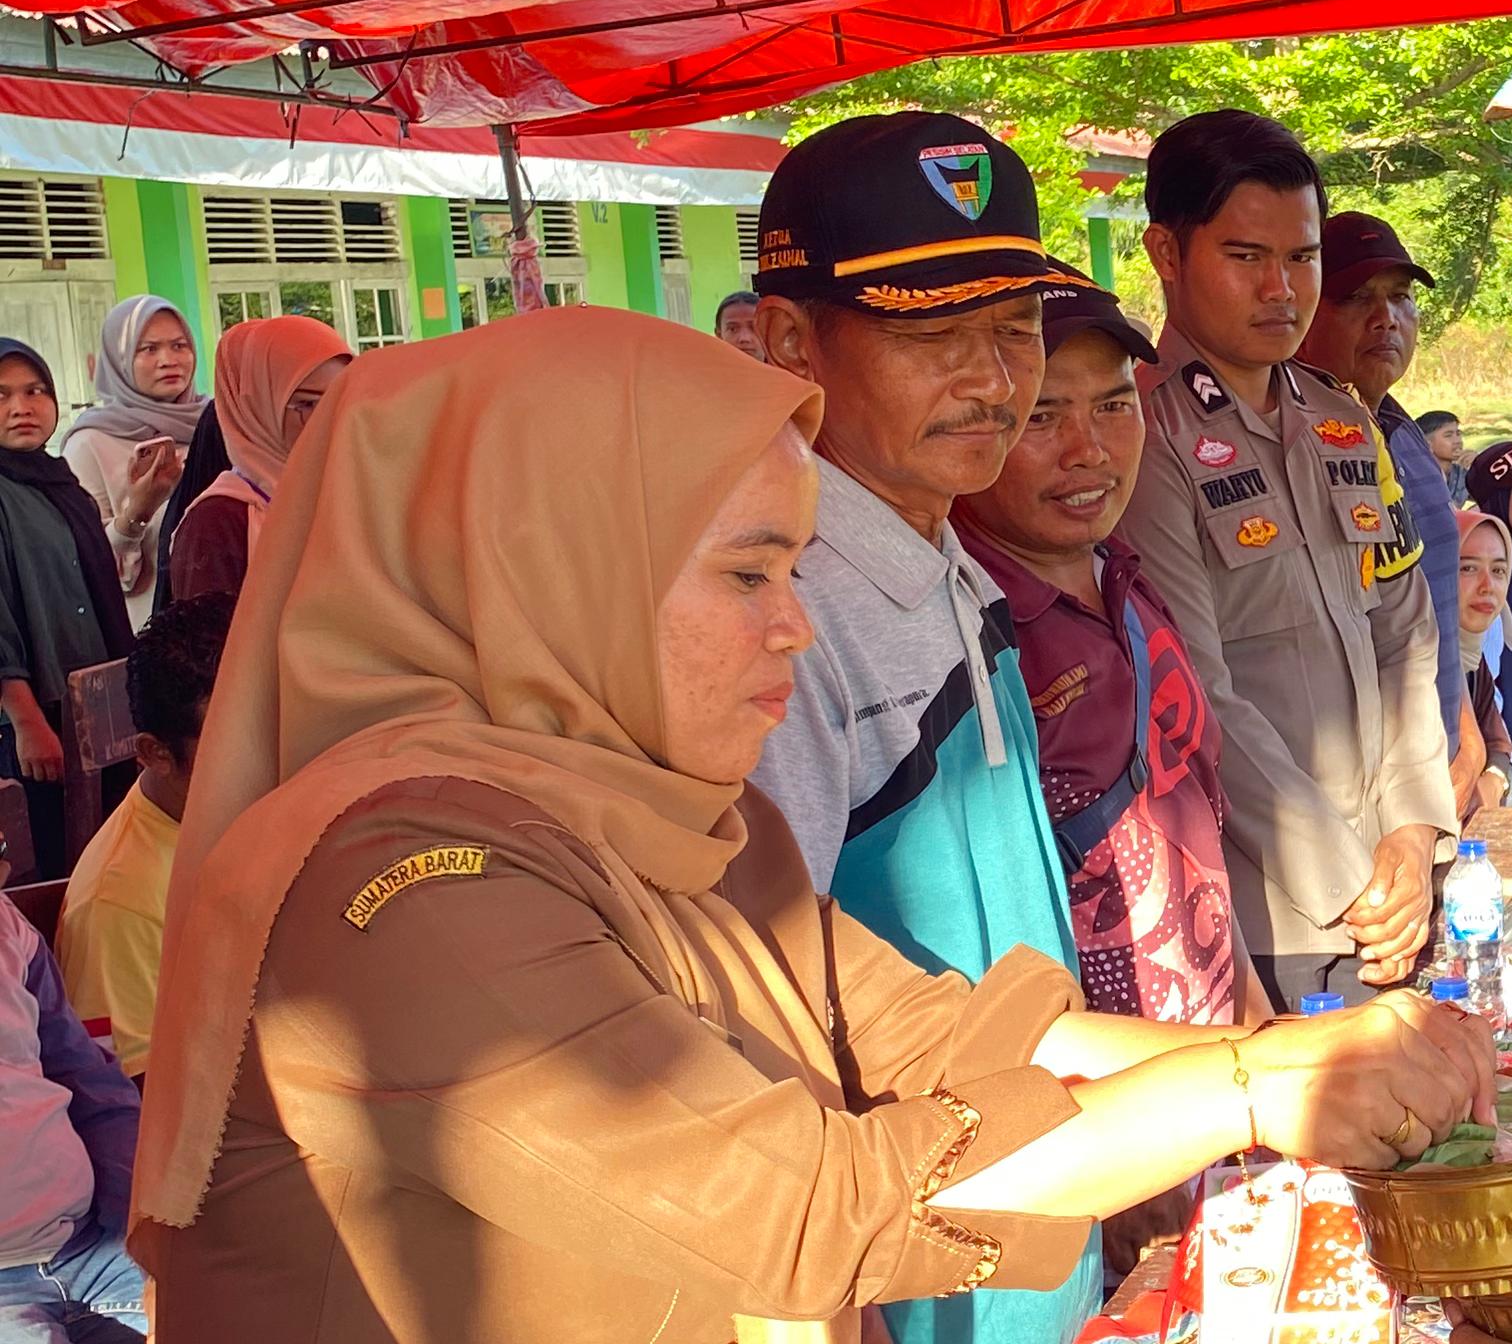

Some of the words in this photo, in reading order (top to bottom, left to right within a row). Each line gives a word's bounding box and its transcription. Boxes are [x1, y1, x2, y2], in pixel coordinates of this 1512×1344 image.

[1201, 468, 1268, 510] WAHYU
[1325, 459, 1379, 488] POLRI
[350, 859, 422, 923] SUMATERA
[424, 849, 482, 873] BARAT
